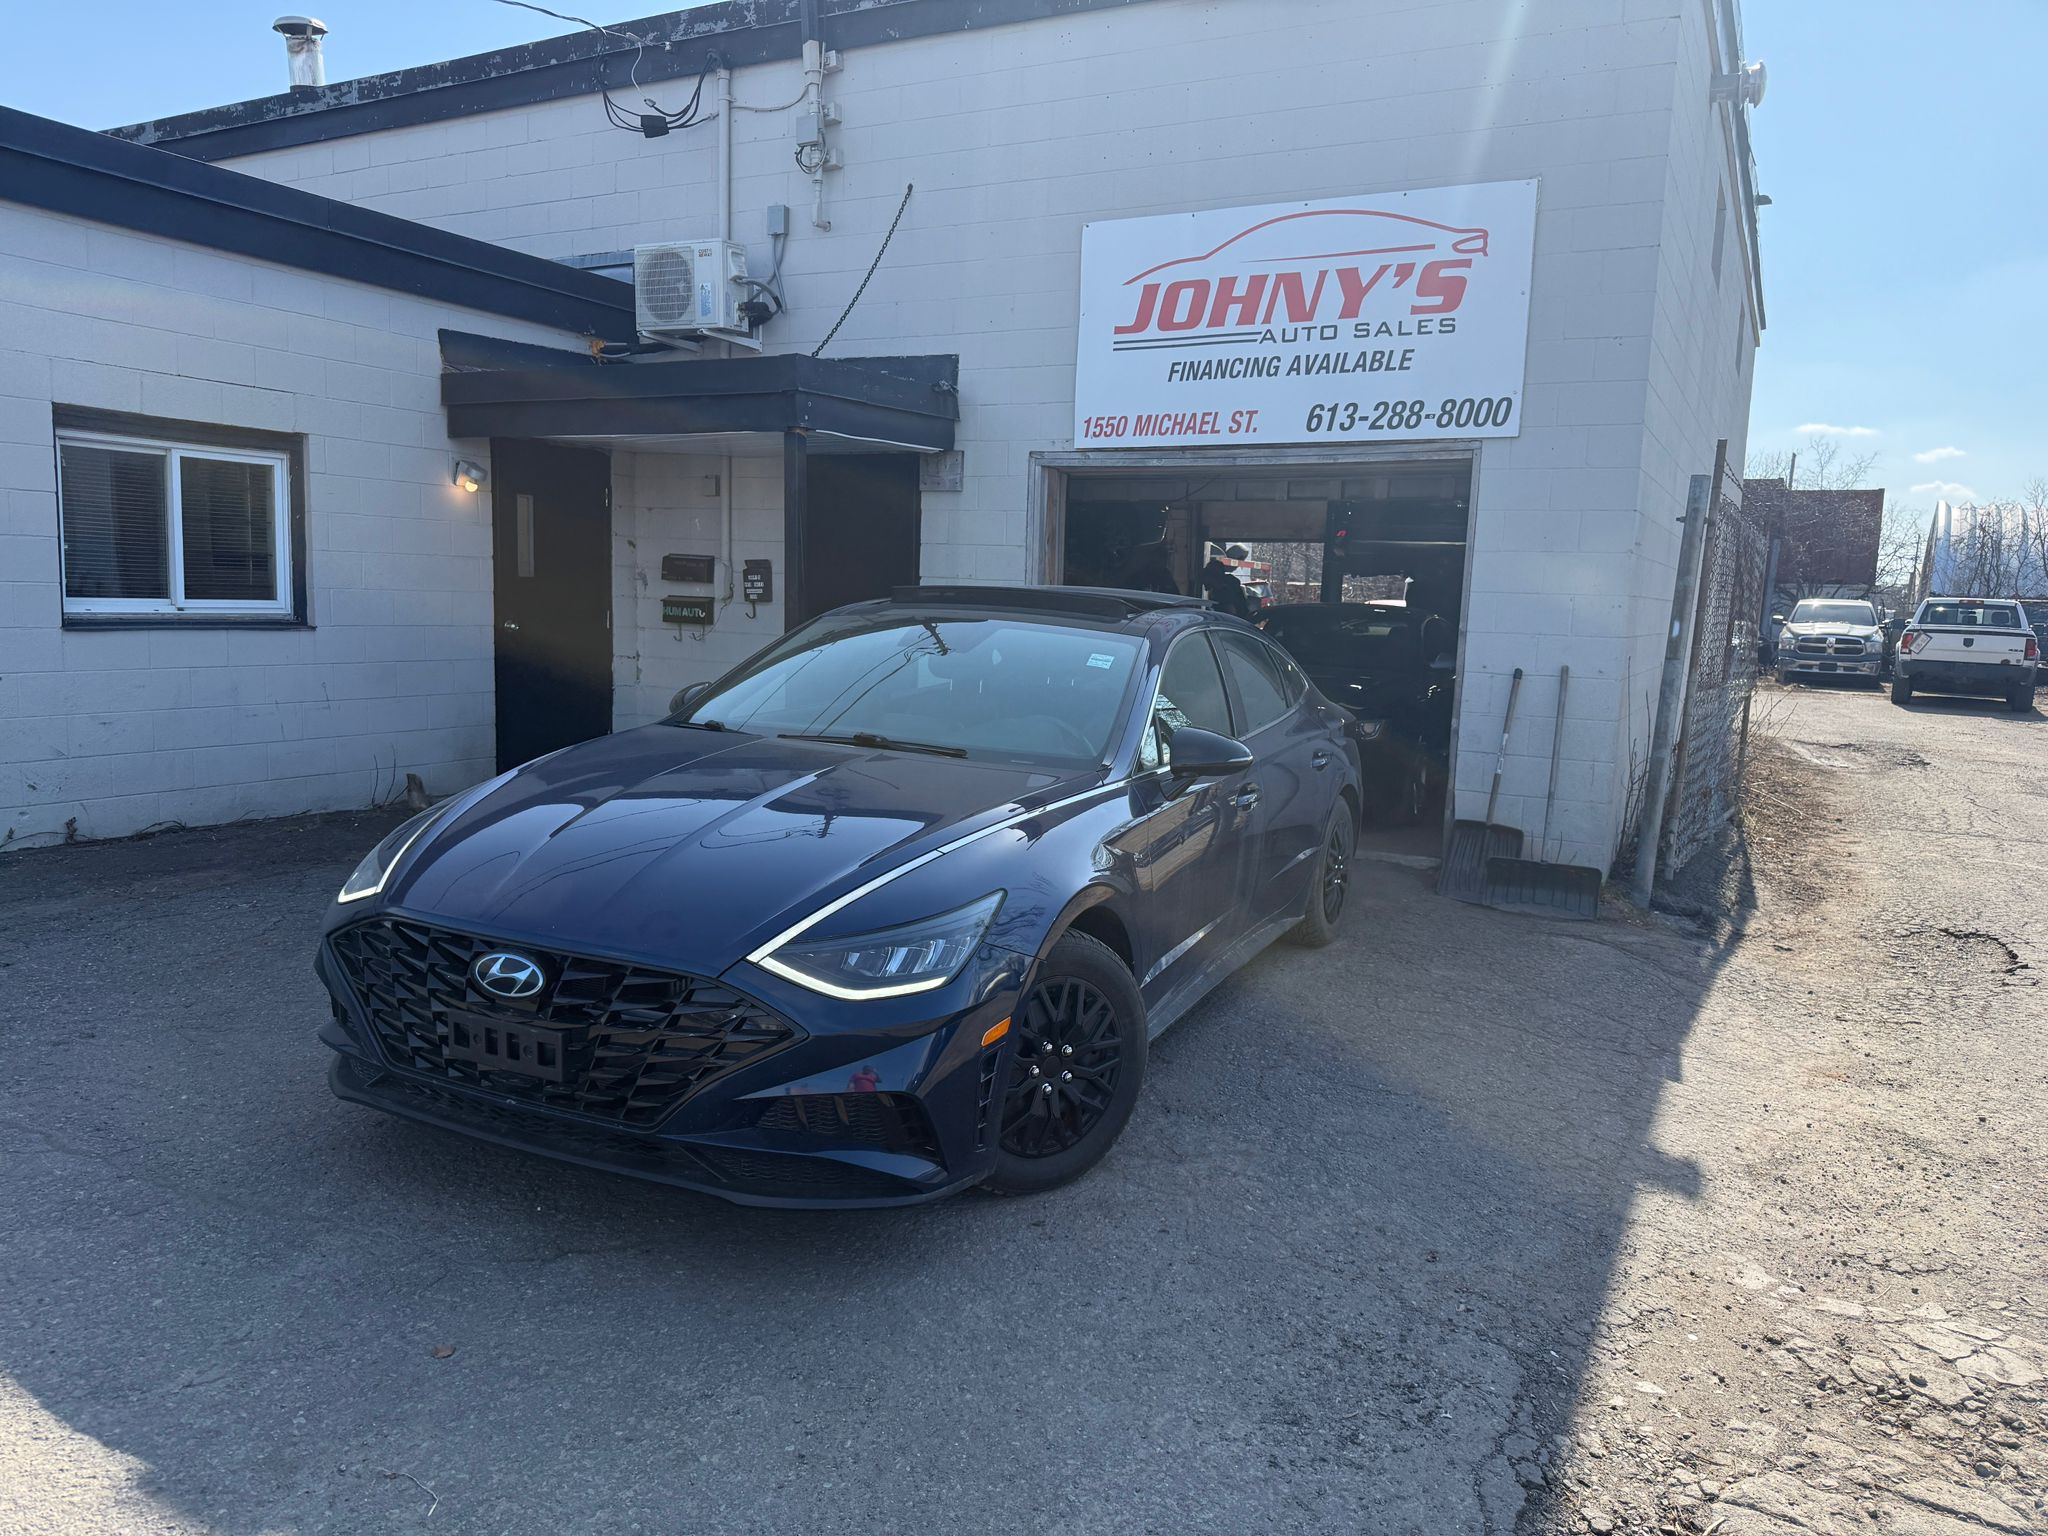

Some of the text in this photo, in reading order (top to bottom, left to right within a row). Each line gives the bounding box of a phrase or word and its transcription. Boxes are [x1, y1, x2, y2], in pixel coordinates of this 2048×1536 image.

[1113, 258, 1473, 335] JOHNY'S
[1259, 317, 1457, 344] AUTO SALES
[1167, 348, 1415, 383] FINANCING AVAILABLE
[1083, 409, 1258, 439] 1550 MICHAEL ST.
[1305, 397, 1513, 433] 613-288-8000
